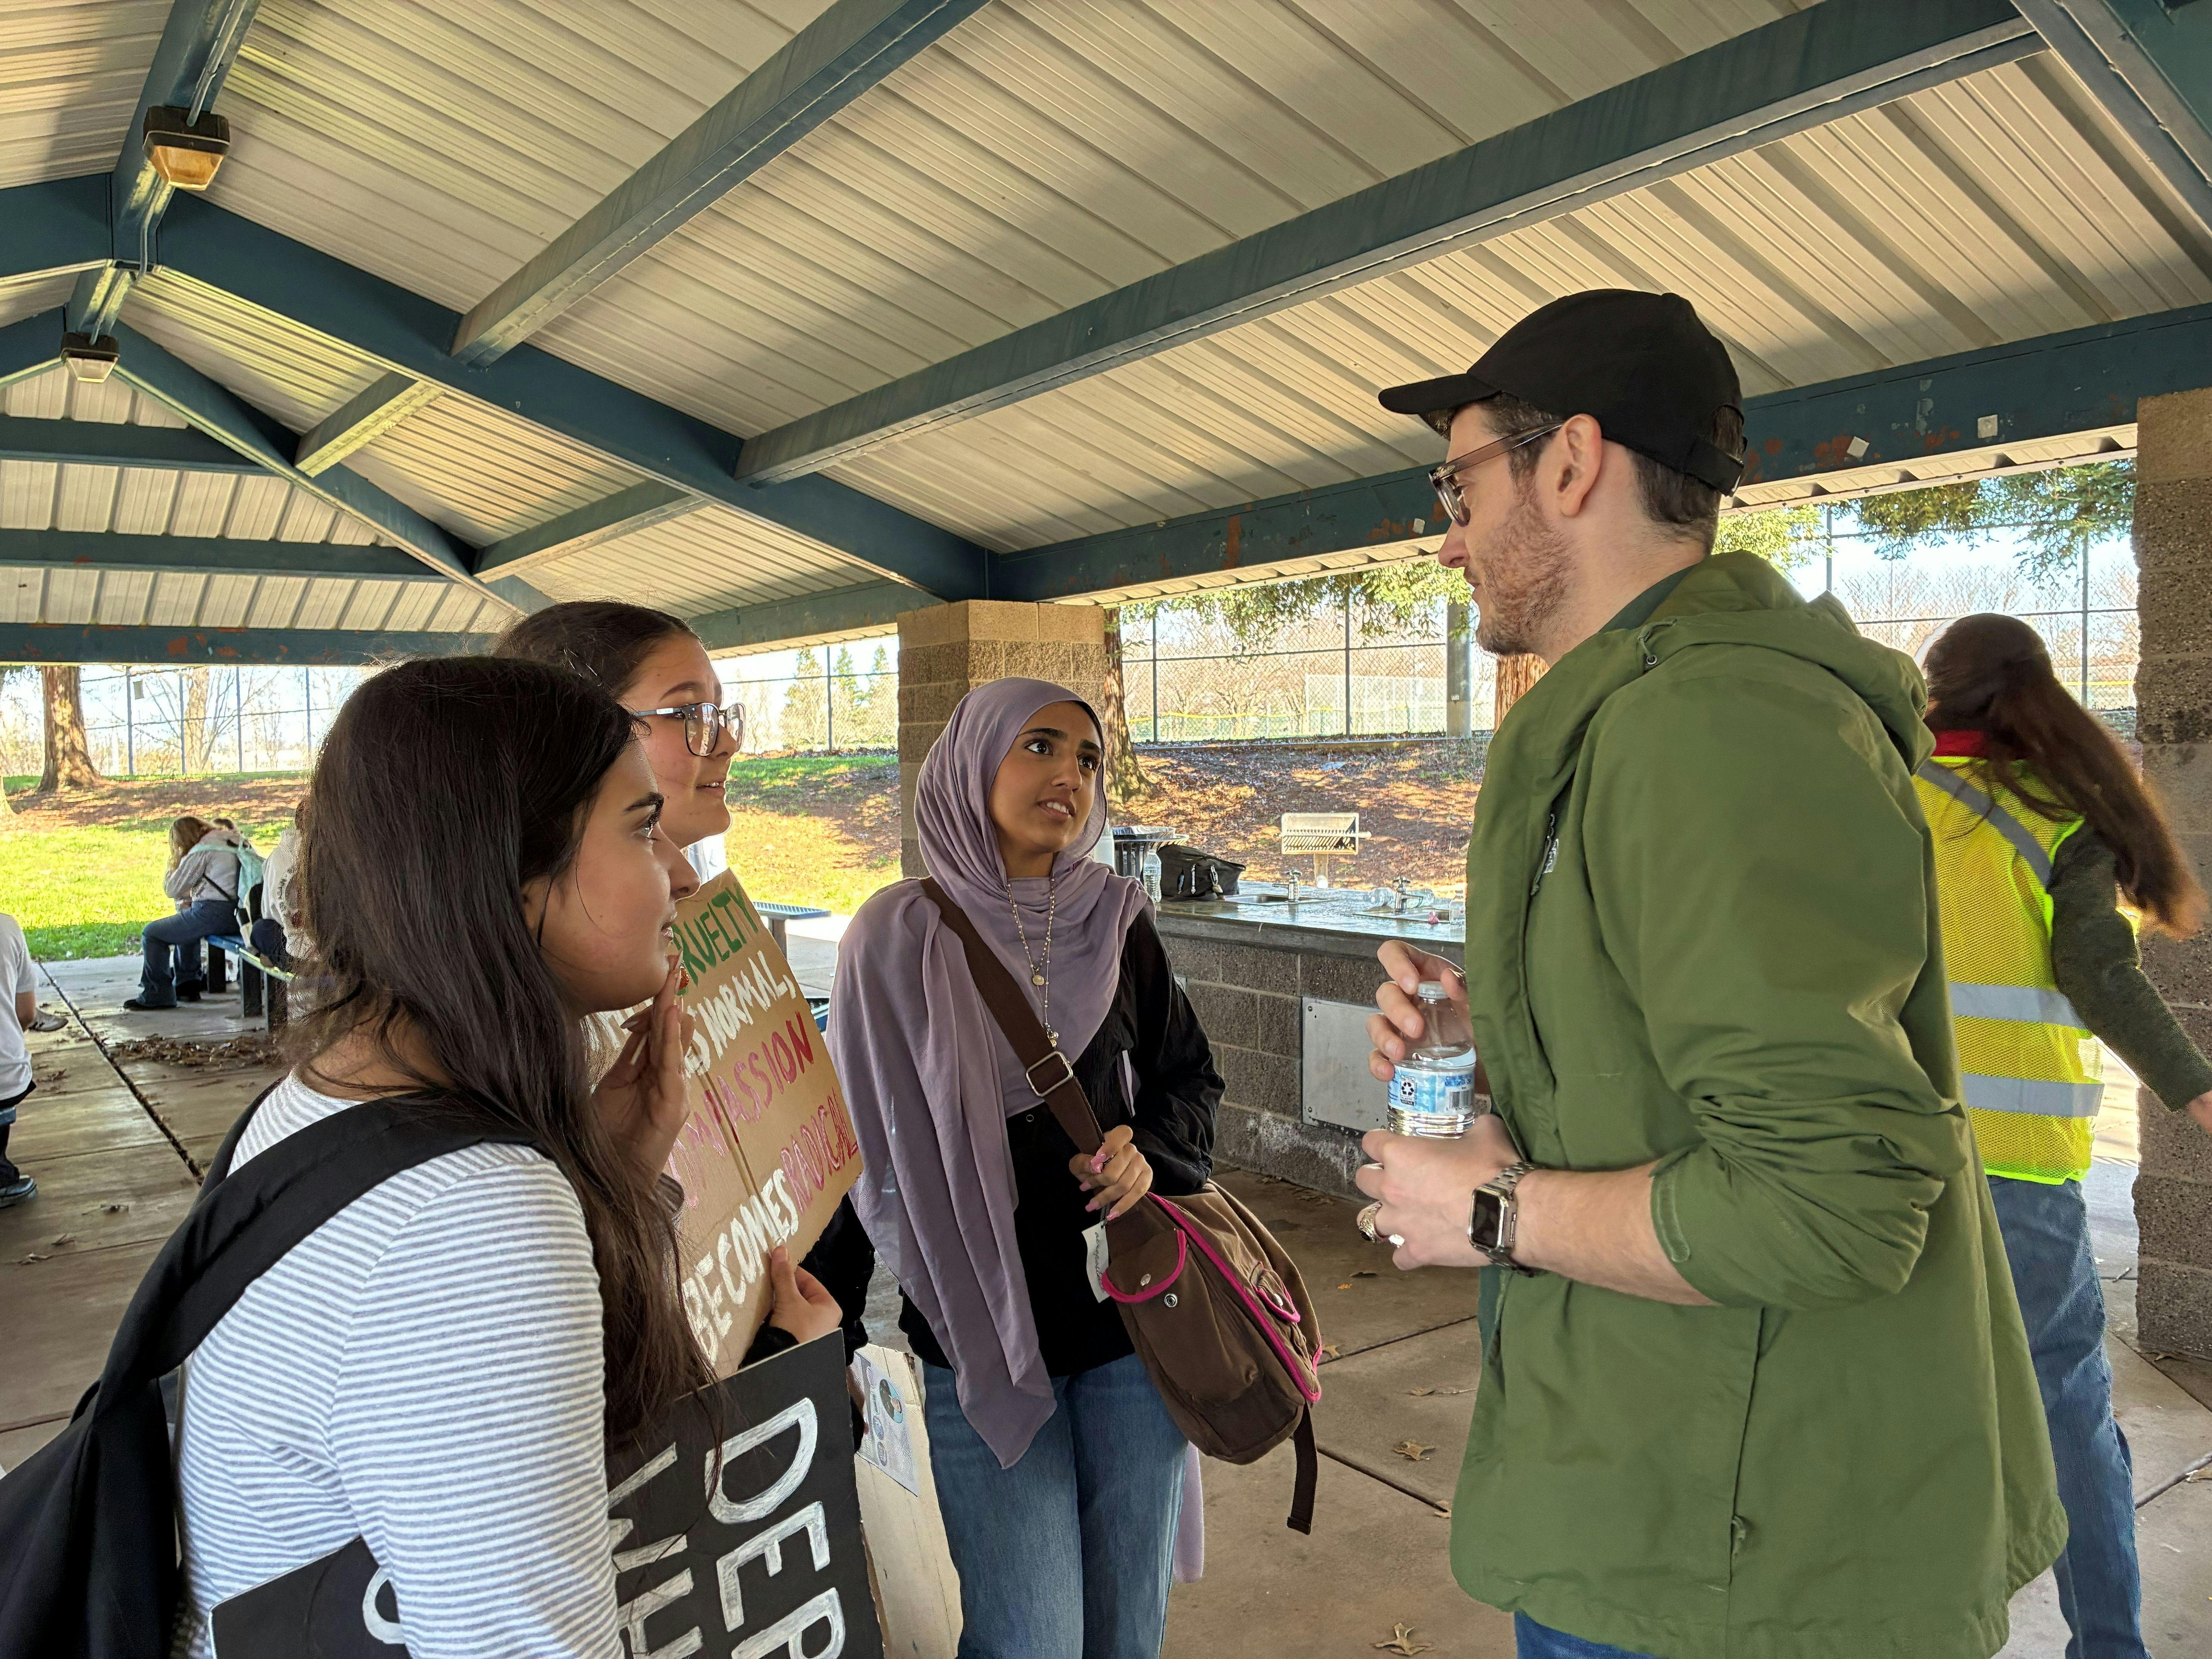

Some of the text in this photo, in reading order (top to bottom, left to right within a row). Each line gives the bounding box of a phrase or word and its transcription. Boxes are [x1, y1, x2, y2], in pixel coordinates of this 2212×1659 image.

[671, 883, 759, 996] RUELTY
[697, 950, 796, 1060] NORMAL,
[682, 1087, 858, 1366] BECOMES RADICAL
